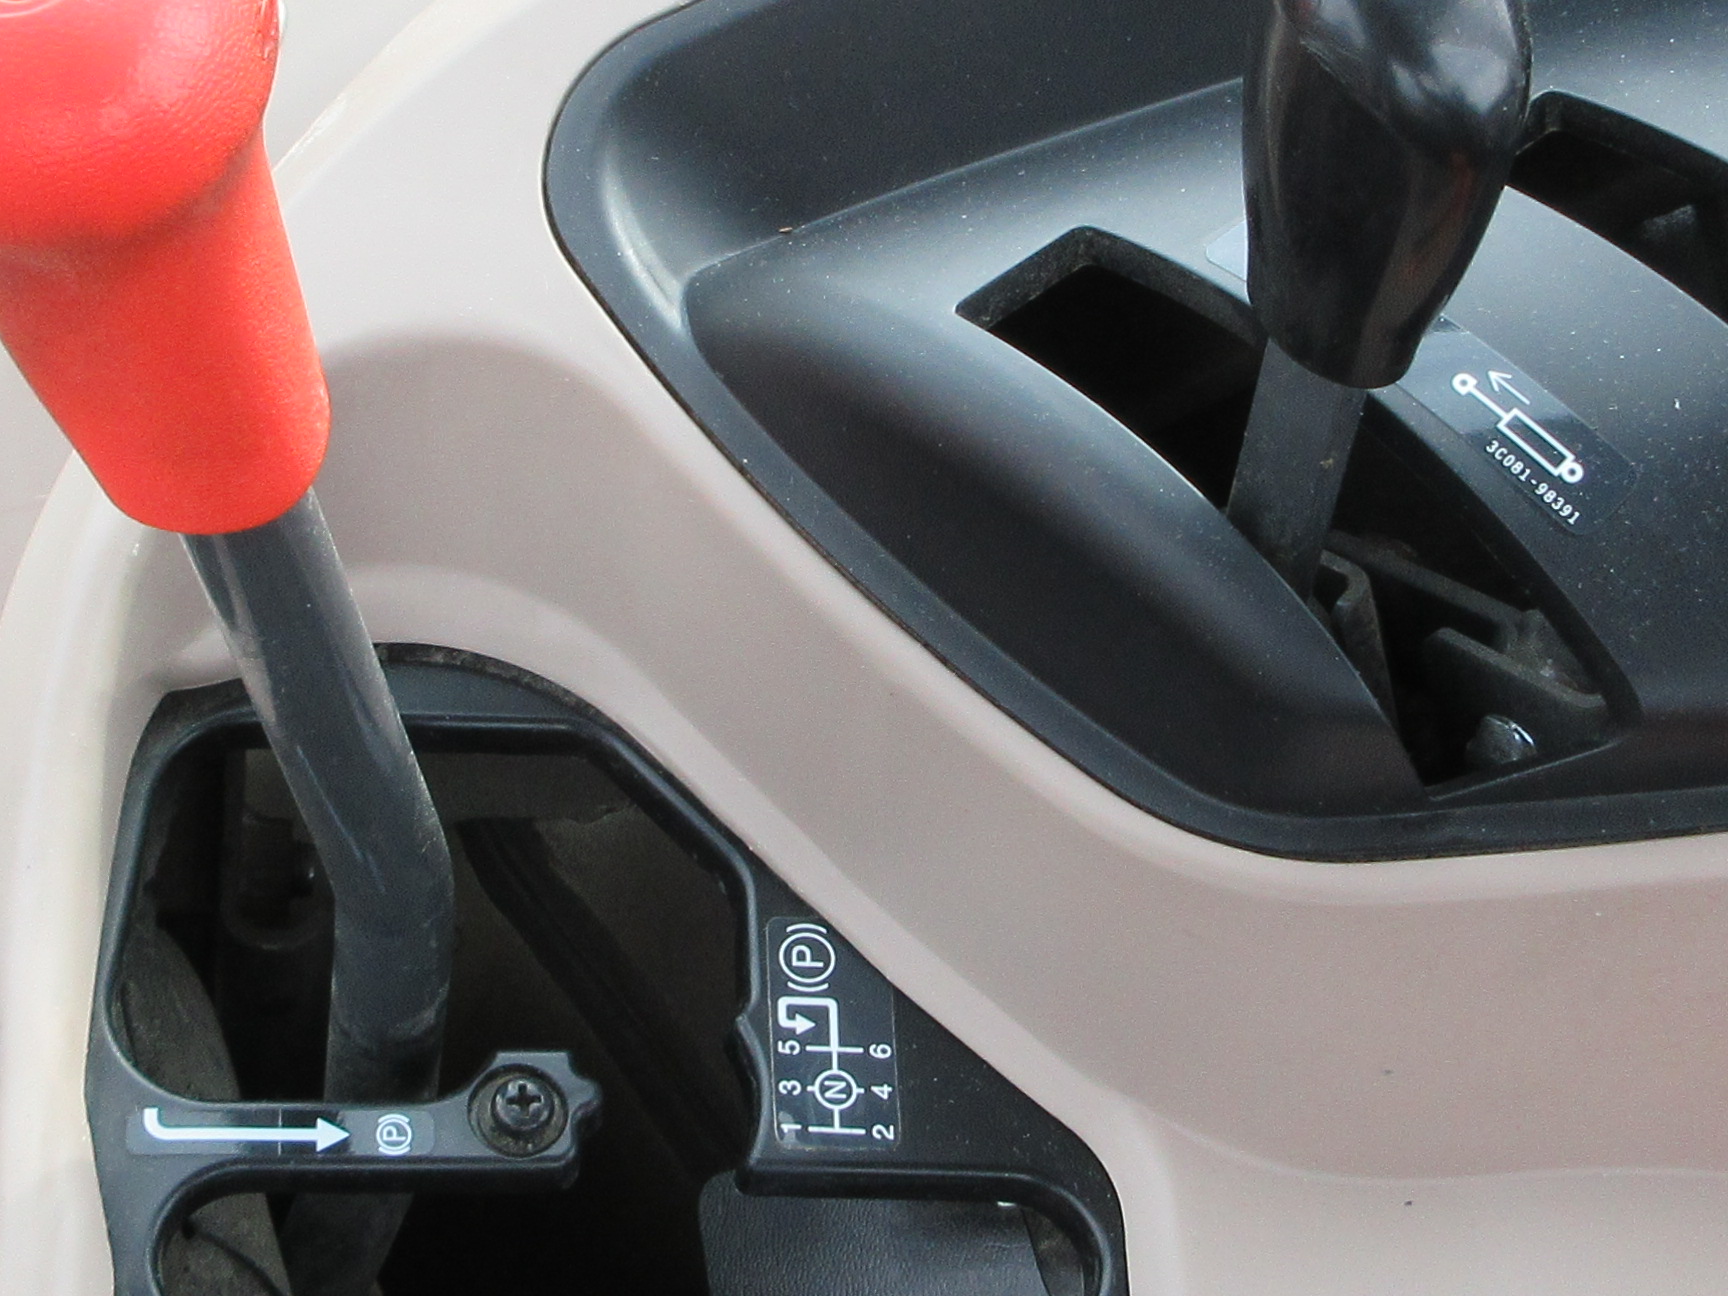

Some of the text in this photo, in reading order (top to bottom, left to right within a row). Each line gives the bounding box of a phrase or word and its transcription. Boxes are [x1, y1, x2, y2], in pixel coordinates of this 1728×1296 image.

[777, 1040, 801, 1057] 5
[869, 1043, 892, 1060] 6
[778, 1080, 803, 1097] 3
[822, 1080, 847, 1100] N
[870, 1083, 894, 1100] 4
[779, 1122, 802, 1136] 1
[872, 1124, 895, 1141] 2
